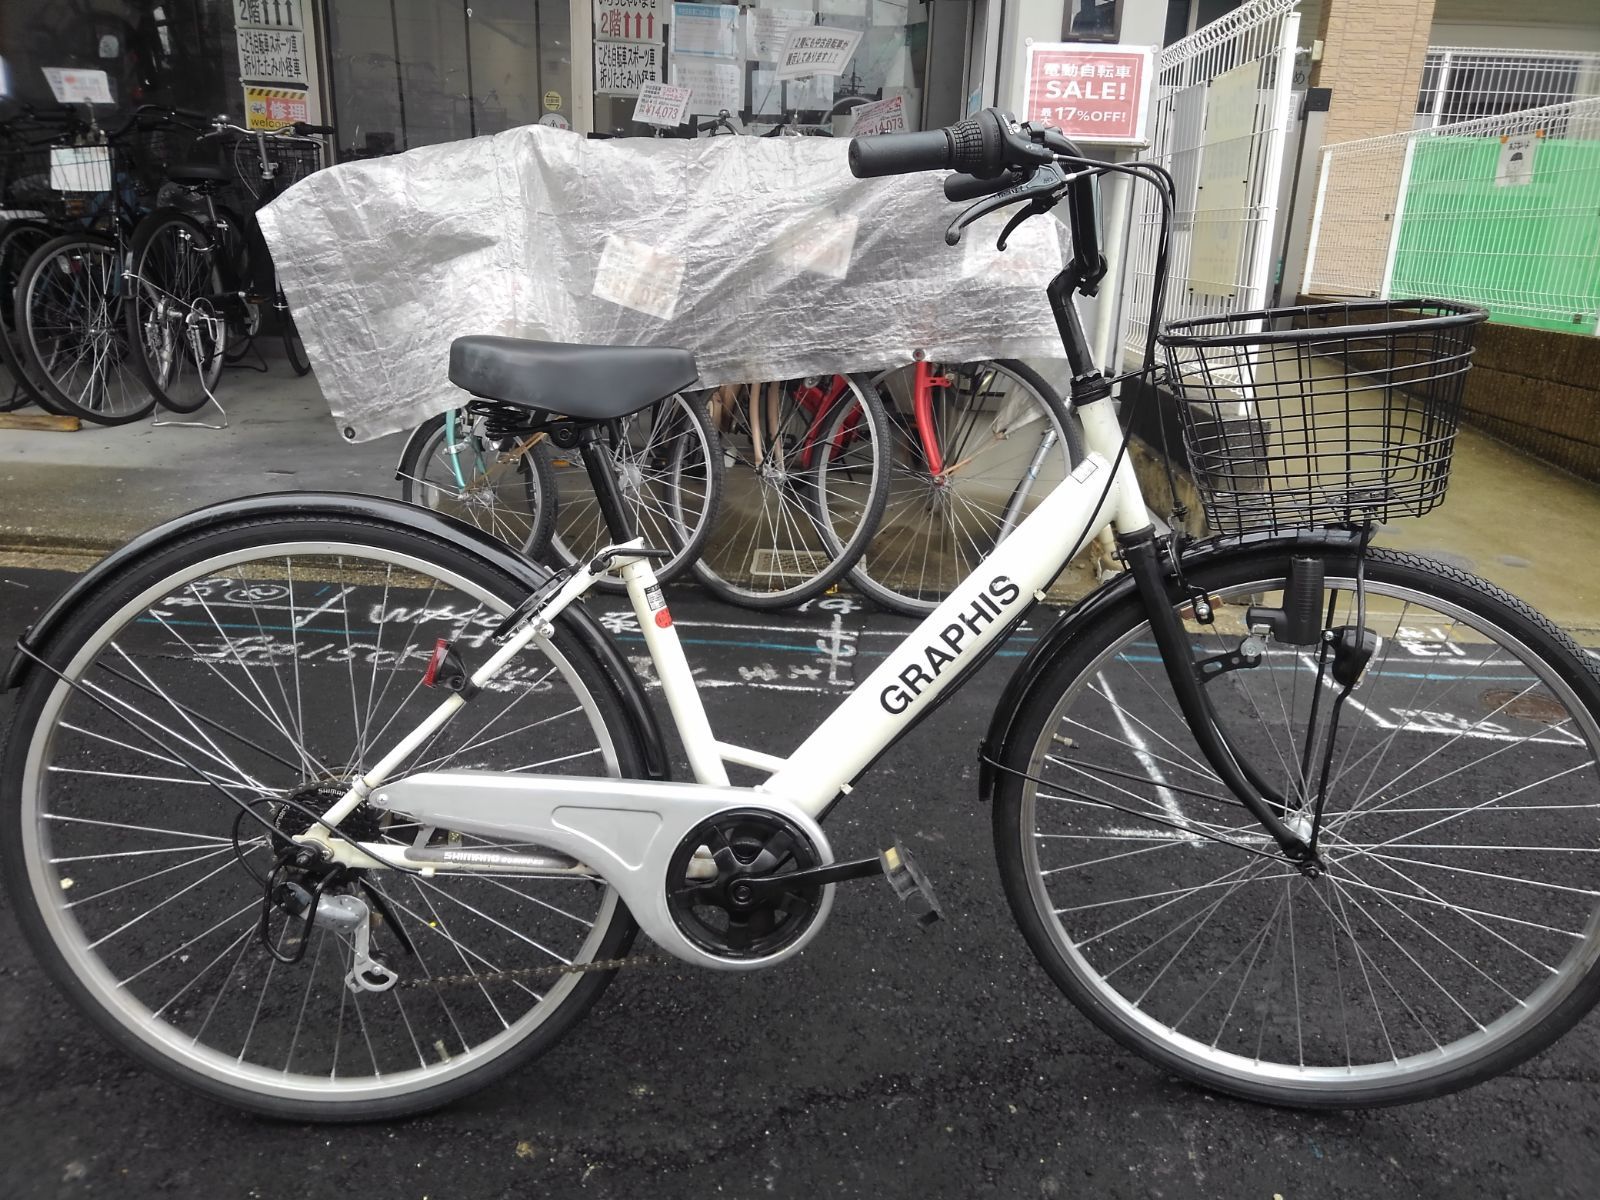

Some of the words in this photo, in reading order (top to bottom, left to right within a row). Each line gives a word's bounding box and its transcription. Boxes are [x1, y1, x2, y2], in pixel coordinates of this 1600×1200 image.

[600, 9, 622, 38] 2階
[240, 31, 298, 56] こども自転車スポーツ車
[598, 44, 656, 69] こども自転車スポーツ車
[1043, 62, 1132, 79] 電動自転車
[1044, 79, 1127, 101] SALE!
[270, 100, 306, 122] 修理
[1055, 106, 1126, 123] 17%OFF!
[250, 117, 291, 129] welcom
[880, 575, 1020, 715] GRAPHIS
[317, 787, 347, 797] SHIMAN
